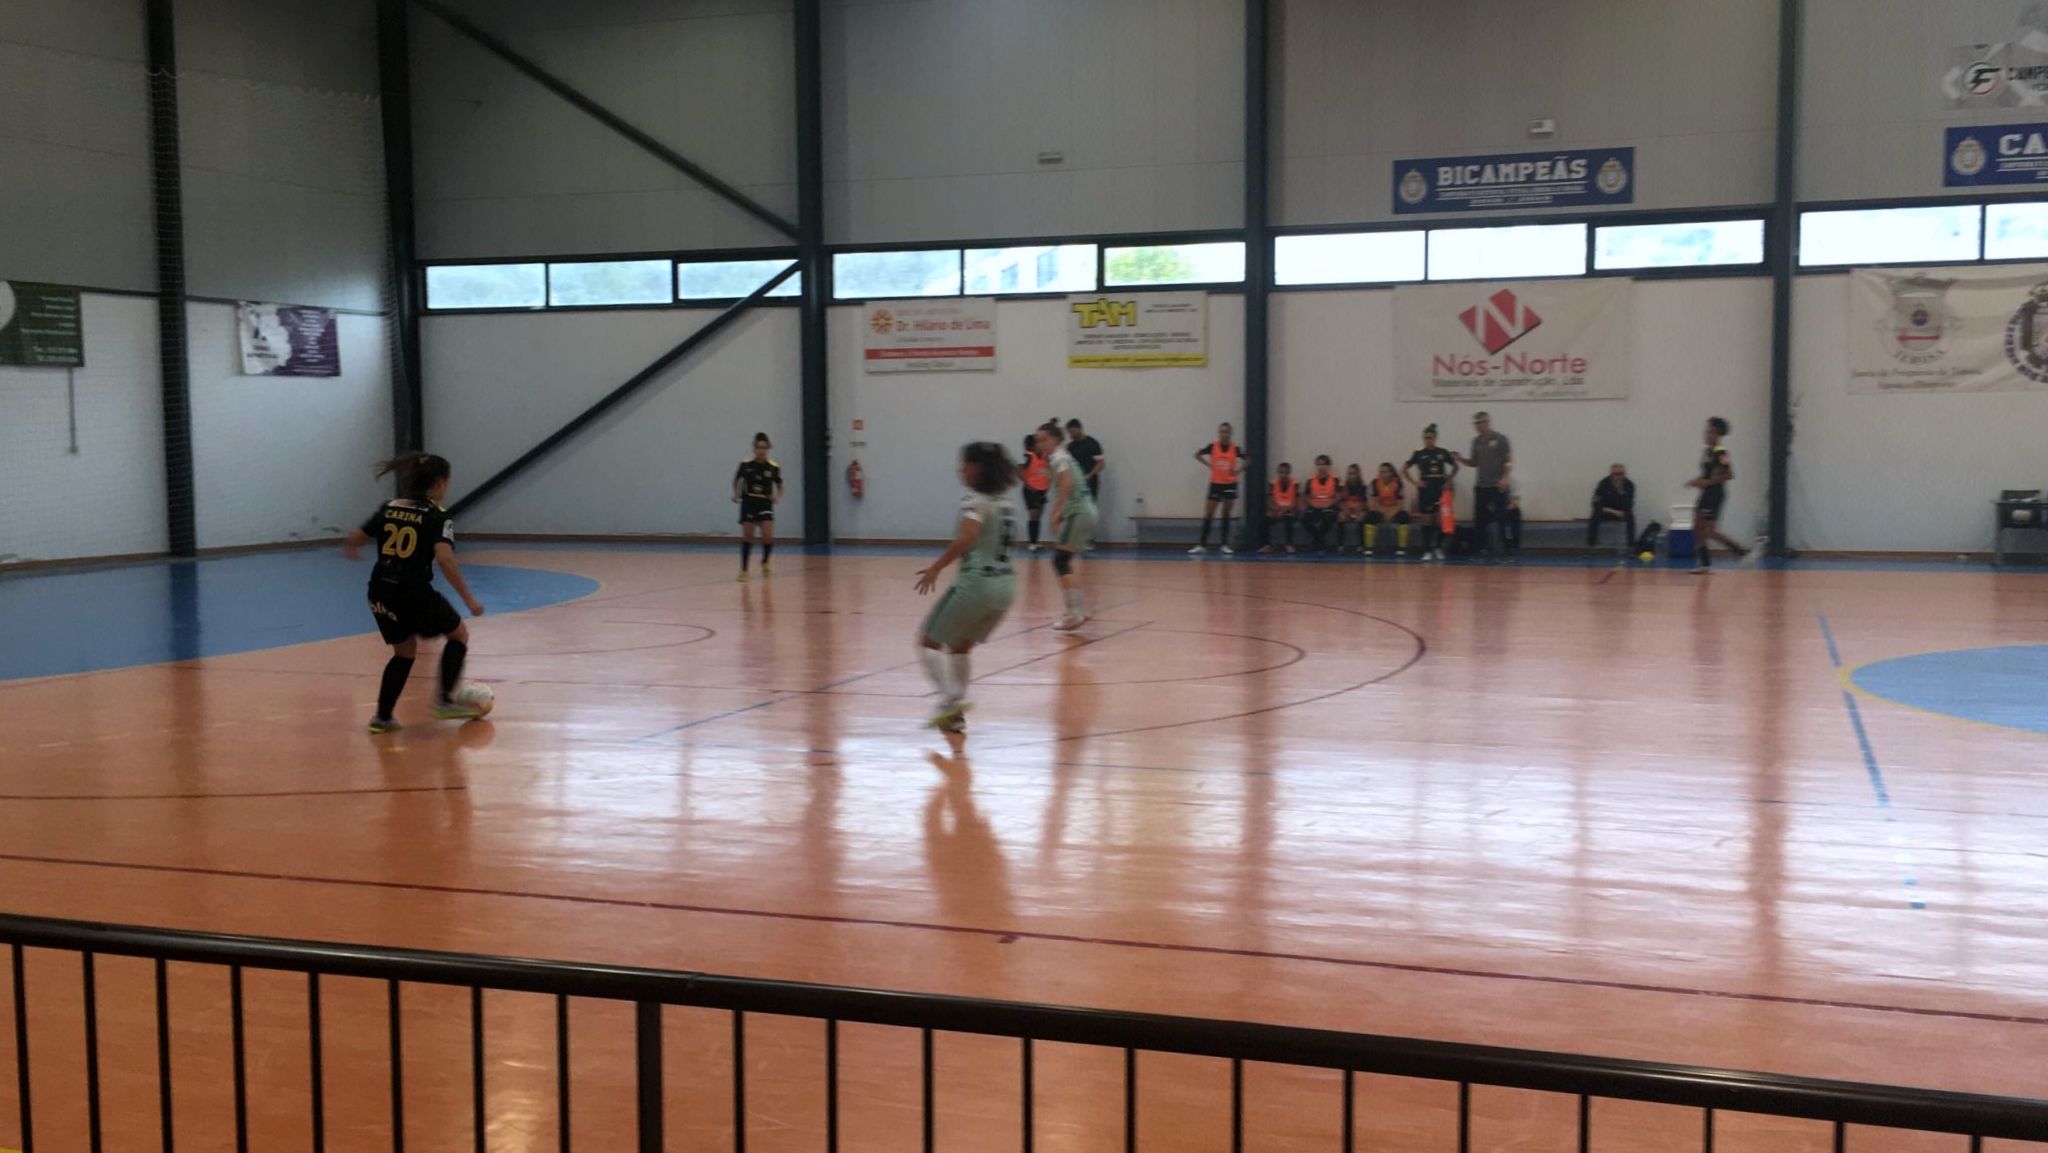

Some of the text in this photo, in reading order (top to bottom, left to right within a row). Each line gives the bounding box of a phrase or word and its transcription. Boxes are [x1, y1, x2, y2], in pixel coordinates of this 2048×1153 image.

[1436, 155, 1588, 186] BICAMPEÃS
[1432, 351, 1587, 376] Nós-Norte
[385, 510, 422, 524] CARINA
[382, 523, 418, 559] 20
